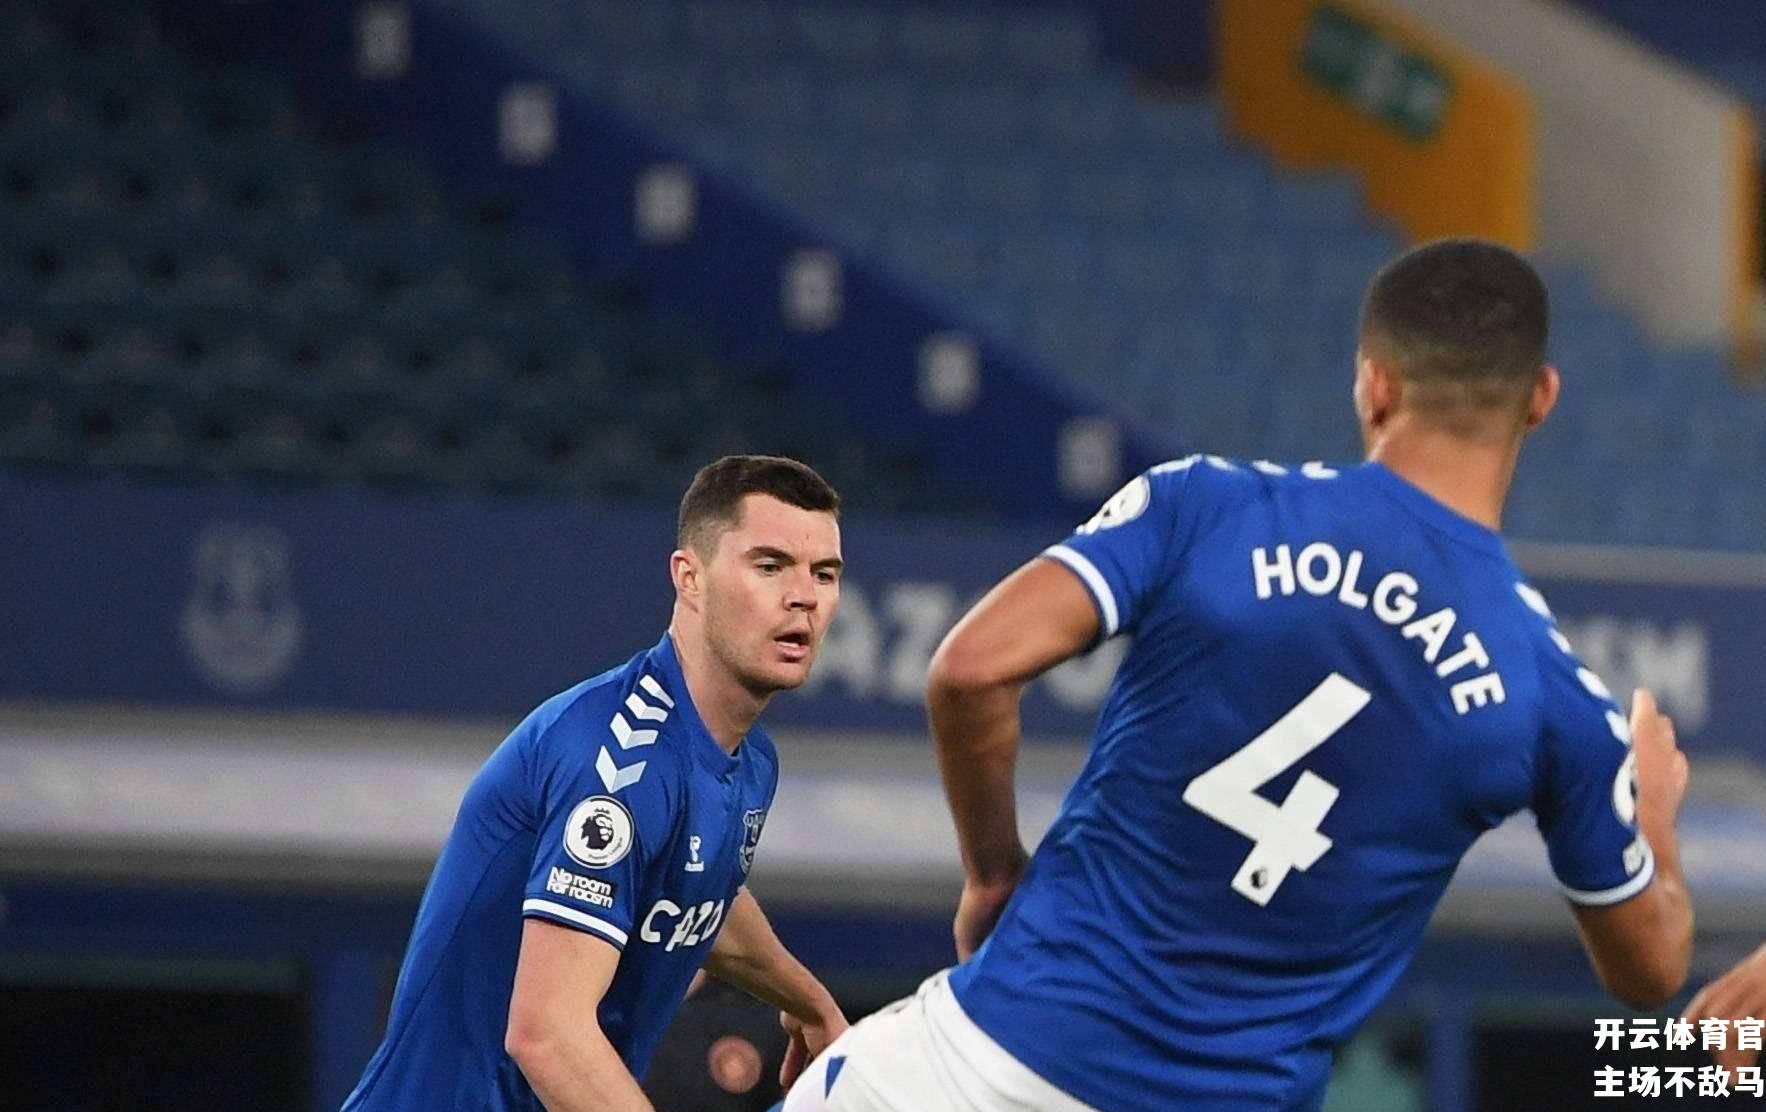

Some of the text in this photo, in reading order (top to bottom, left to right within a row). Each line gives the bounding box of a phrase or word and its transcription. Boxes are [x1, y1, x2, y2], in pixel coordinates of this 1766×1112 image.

[1251, 541, 1506, 716] HOLGATE
[1182, 671, 1373, 907] 4
[568, 886, 613, 909] racism
[572, 874, 612, 896] room
